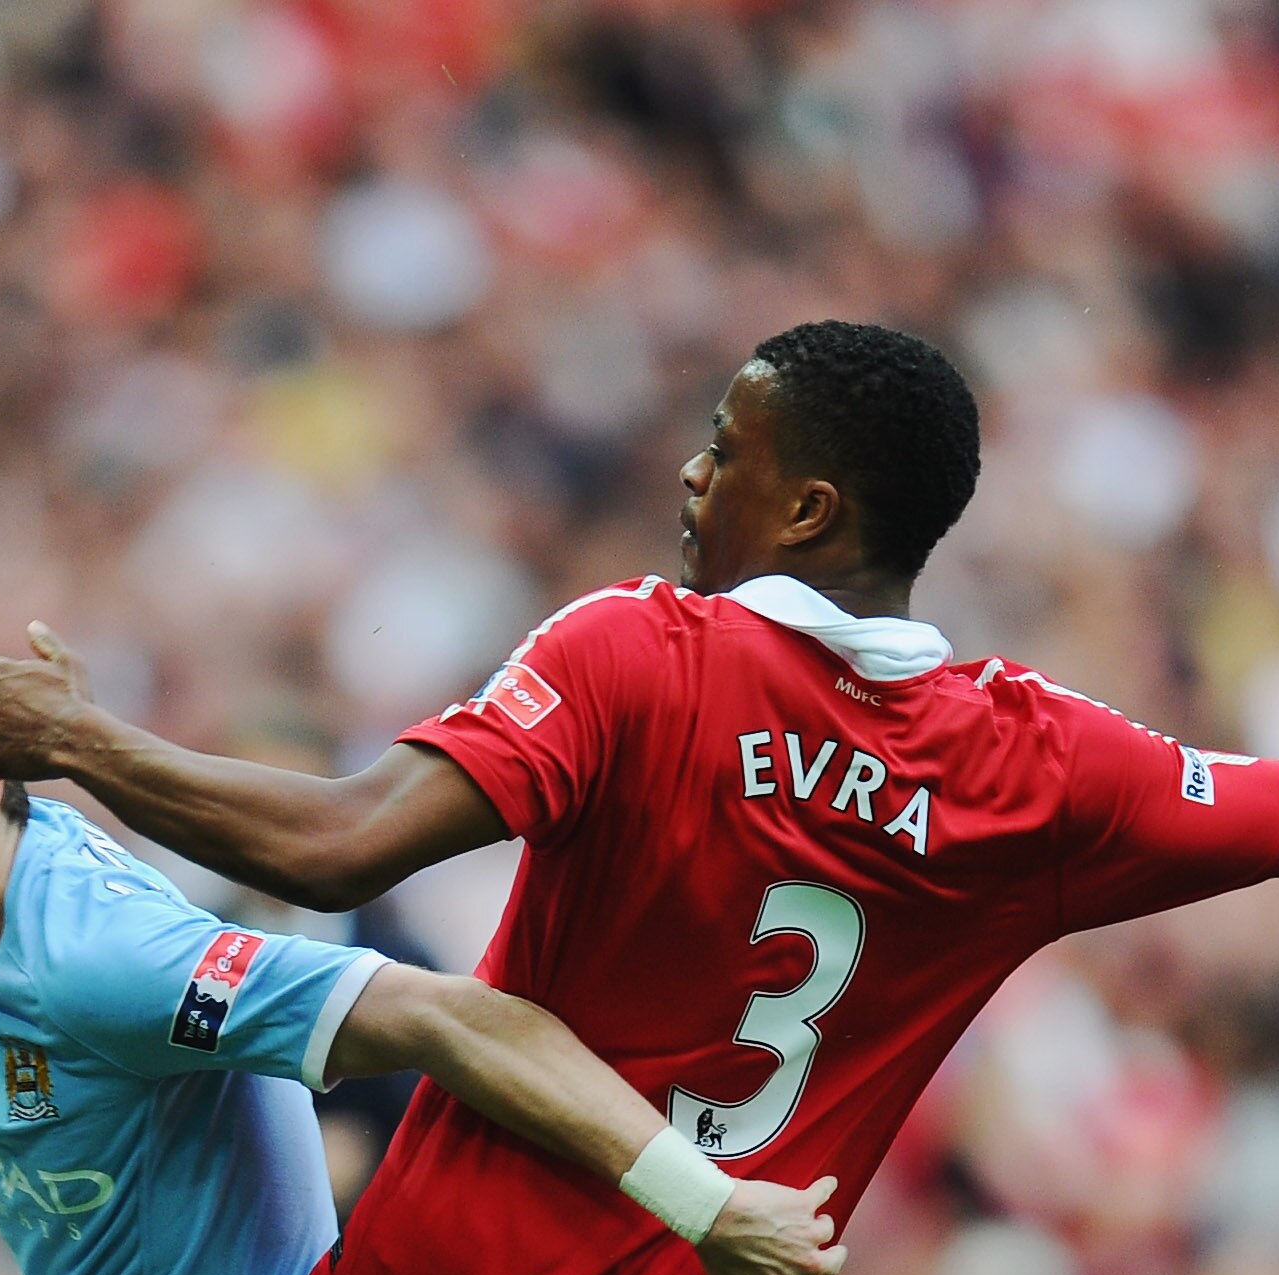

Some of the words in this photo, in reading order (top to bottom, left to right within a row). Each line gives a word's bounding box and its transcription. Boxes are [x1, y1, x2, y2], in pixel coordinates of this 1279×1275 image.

[834, 676, 882, 707] MUFC
[737, 730, 930, 857] EVRA
[187, 1009, 202, 1026] FA
[197, 1019, 210, 1040] CUP
[668, 879, 867, 1160] 3
